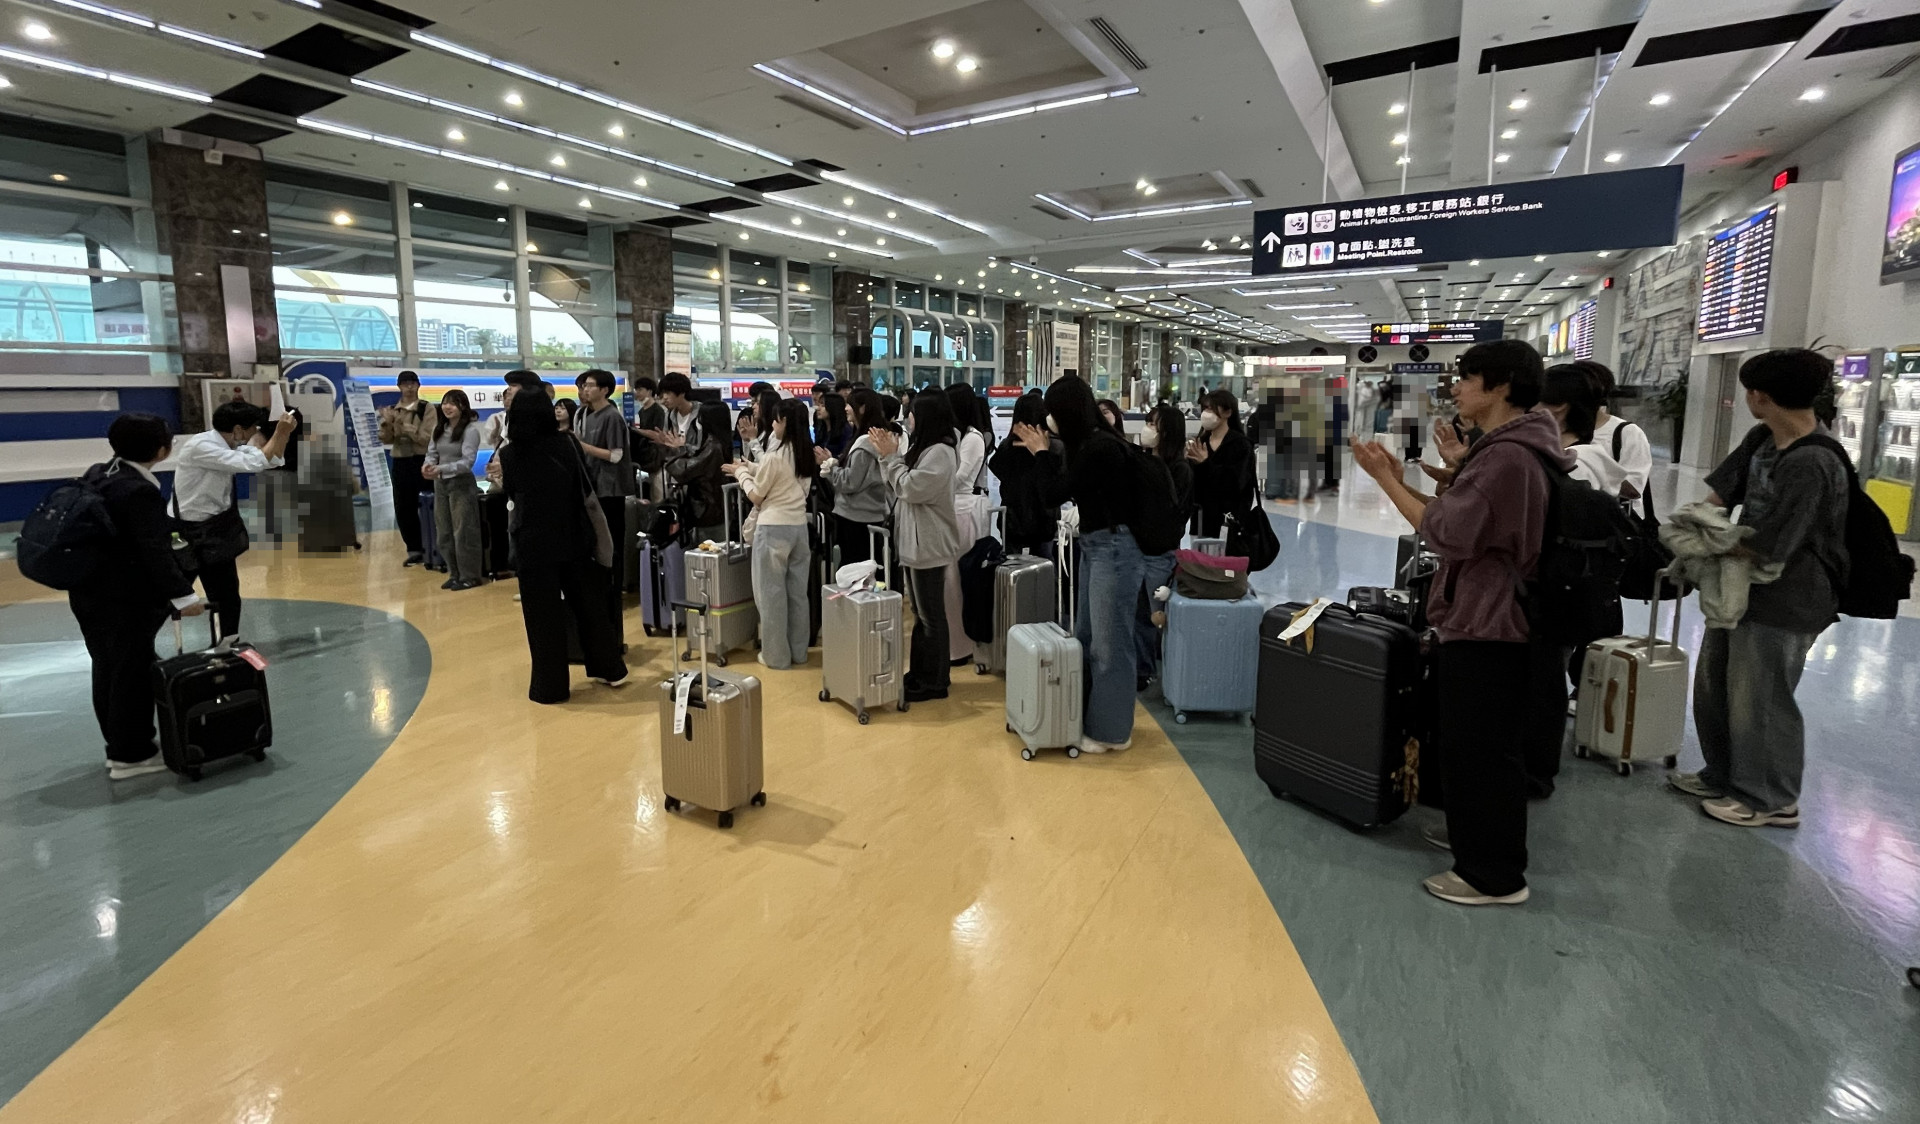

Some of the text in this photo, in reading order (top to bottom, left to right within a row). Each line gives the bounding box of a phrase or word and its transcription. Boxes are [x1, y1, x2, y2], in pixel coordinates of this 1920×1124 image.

[1339, 219, 1363, 228] Animal
[1370, 217, 1388, 225] Plant
[1458, 207, 1490, 216] Workers
[1337, 251, 1365, 260] Meeting
[789, 347, 798, 364] 5
